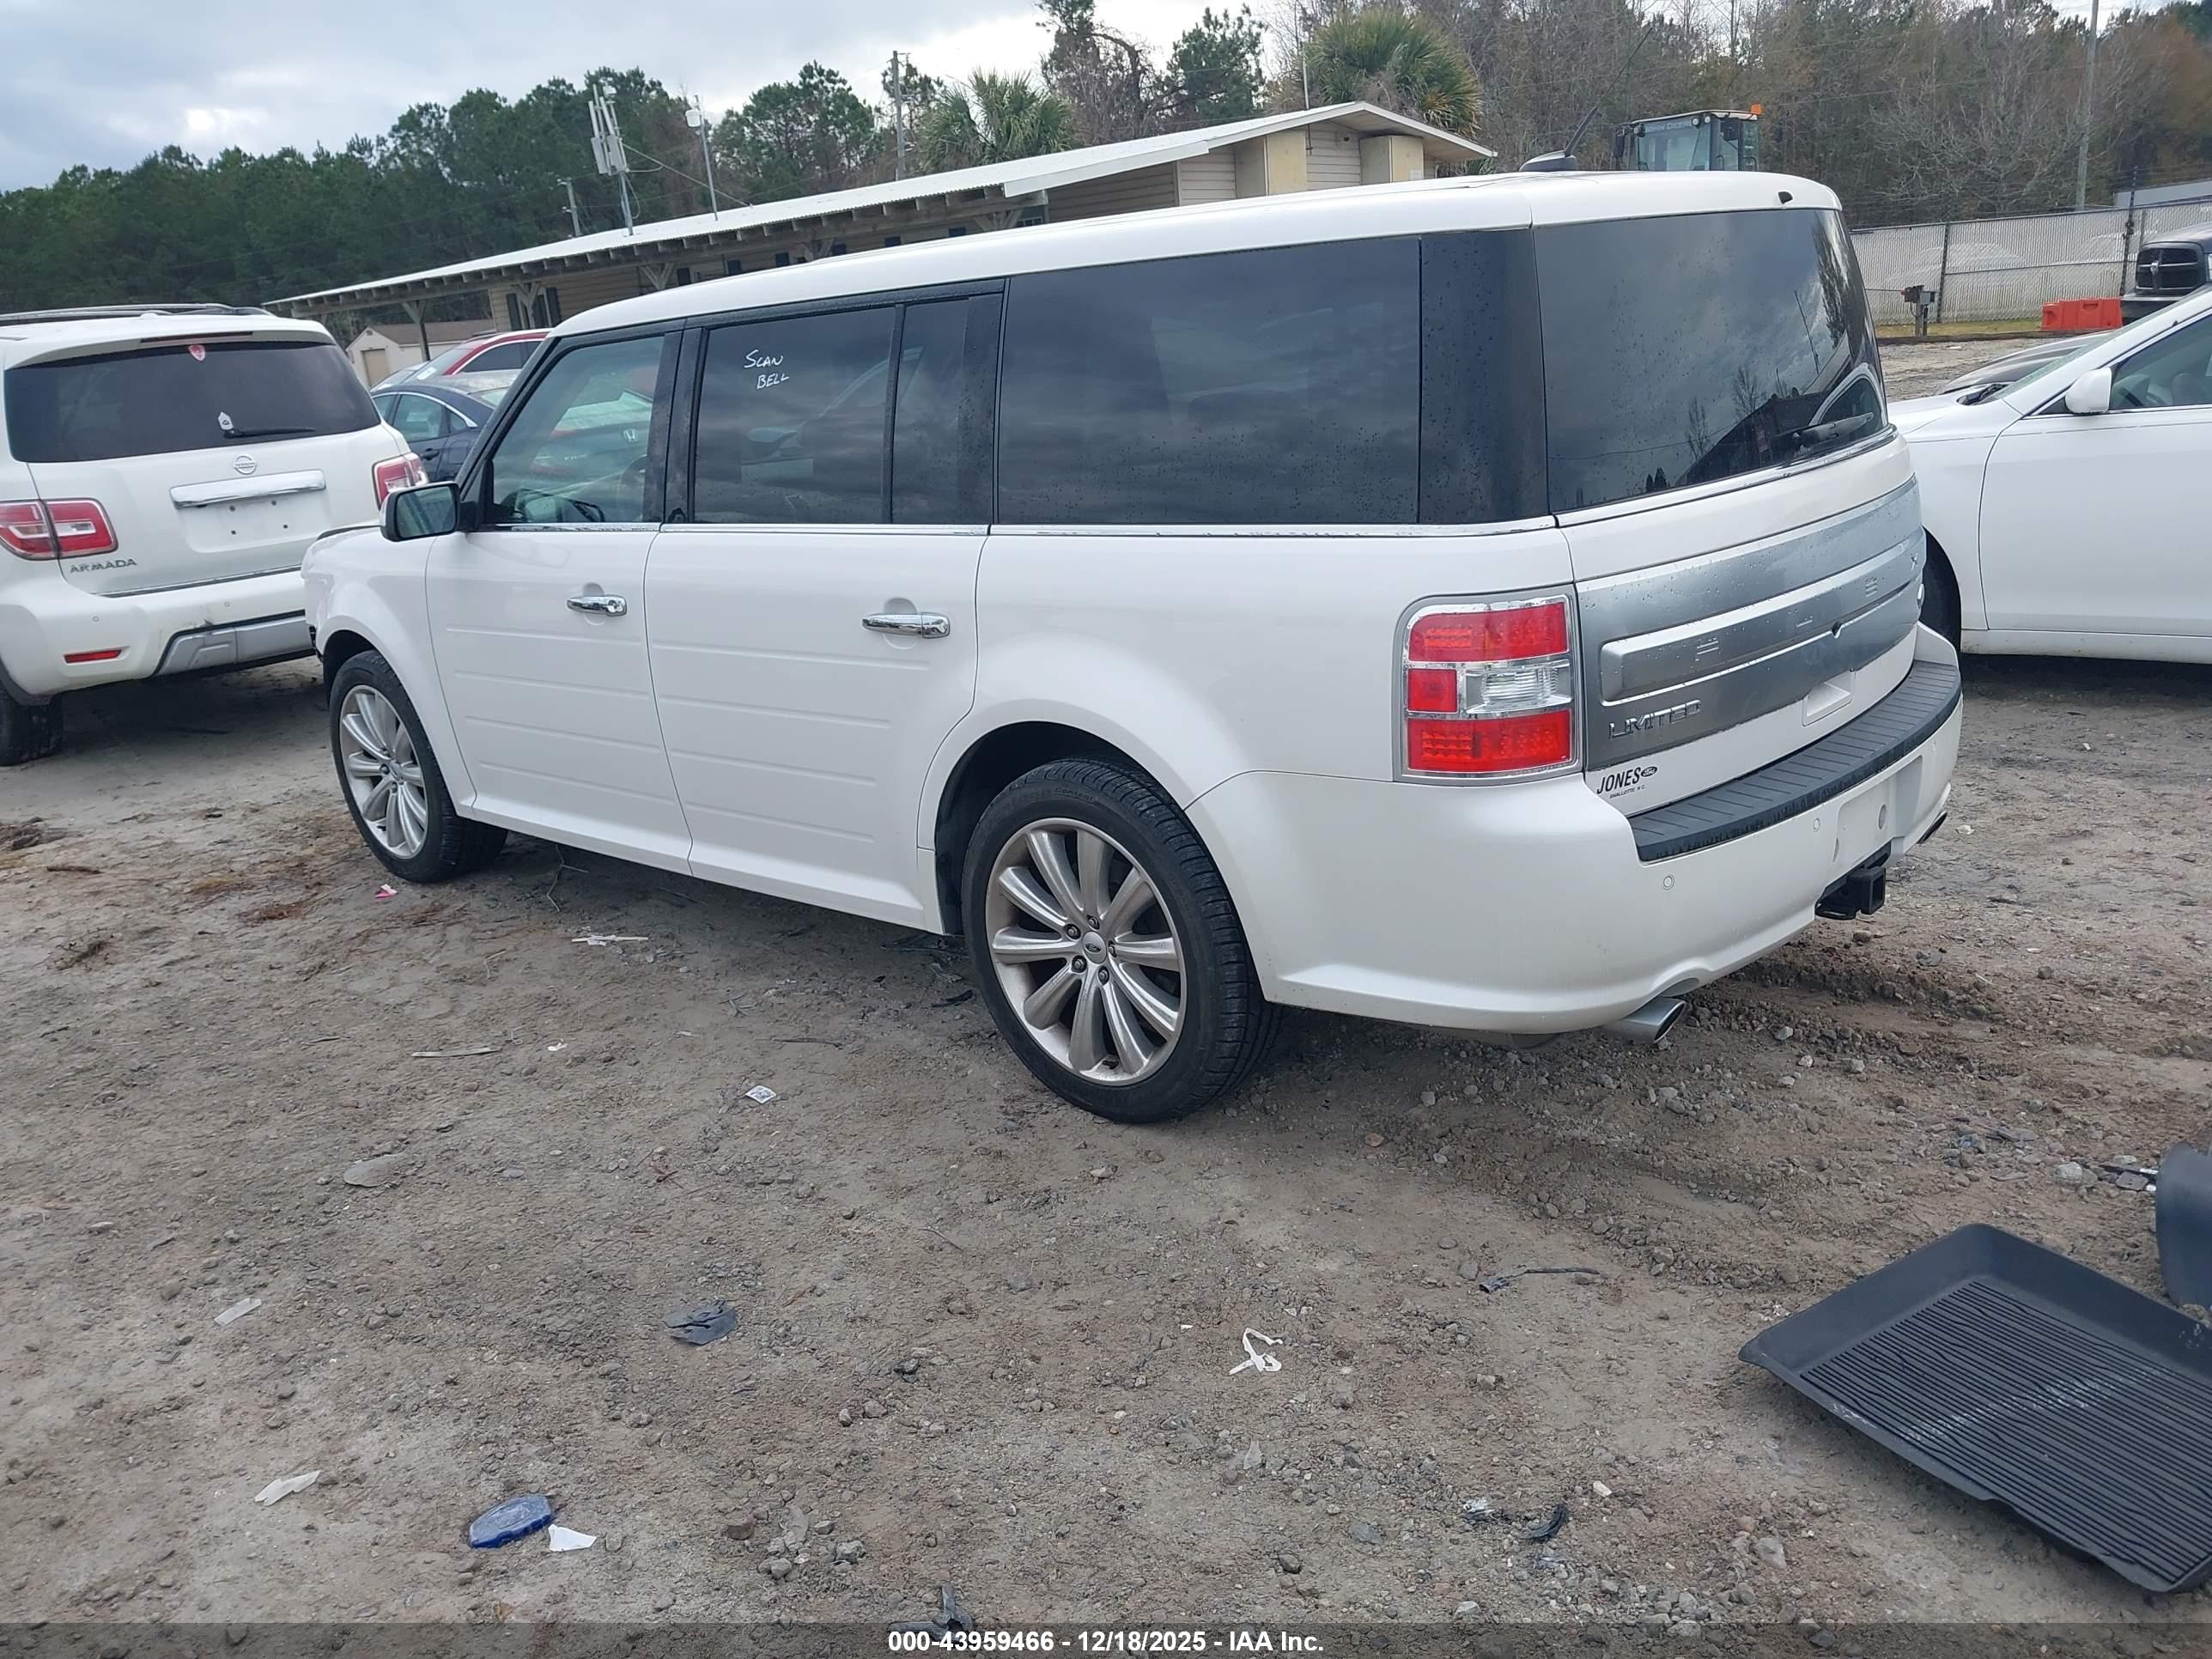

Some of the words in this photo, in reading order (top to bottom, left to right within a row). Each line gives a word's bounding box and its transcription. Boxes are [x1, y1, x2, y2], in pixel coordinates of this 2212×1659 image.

[757, 373, 790, 389] BELL
[70, 558, 138, 574] ARMADA
[1607, 699, 1701, 740] LIMITED
[1597, 767, 1641, 794] JONES
